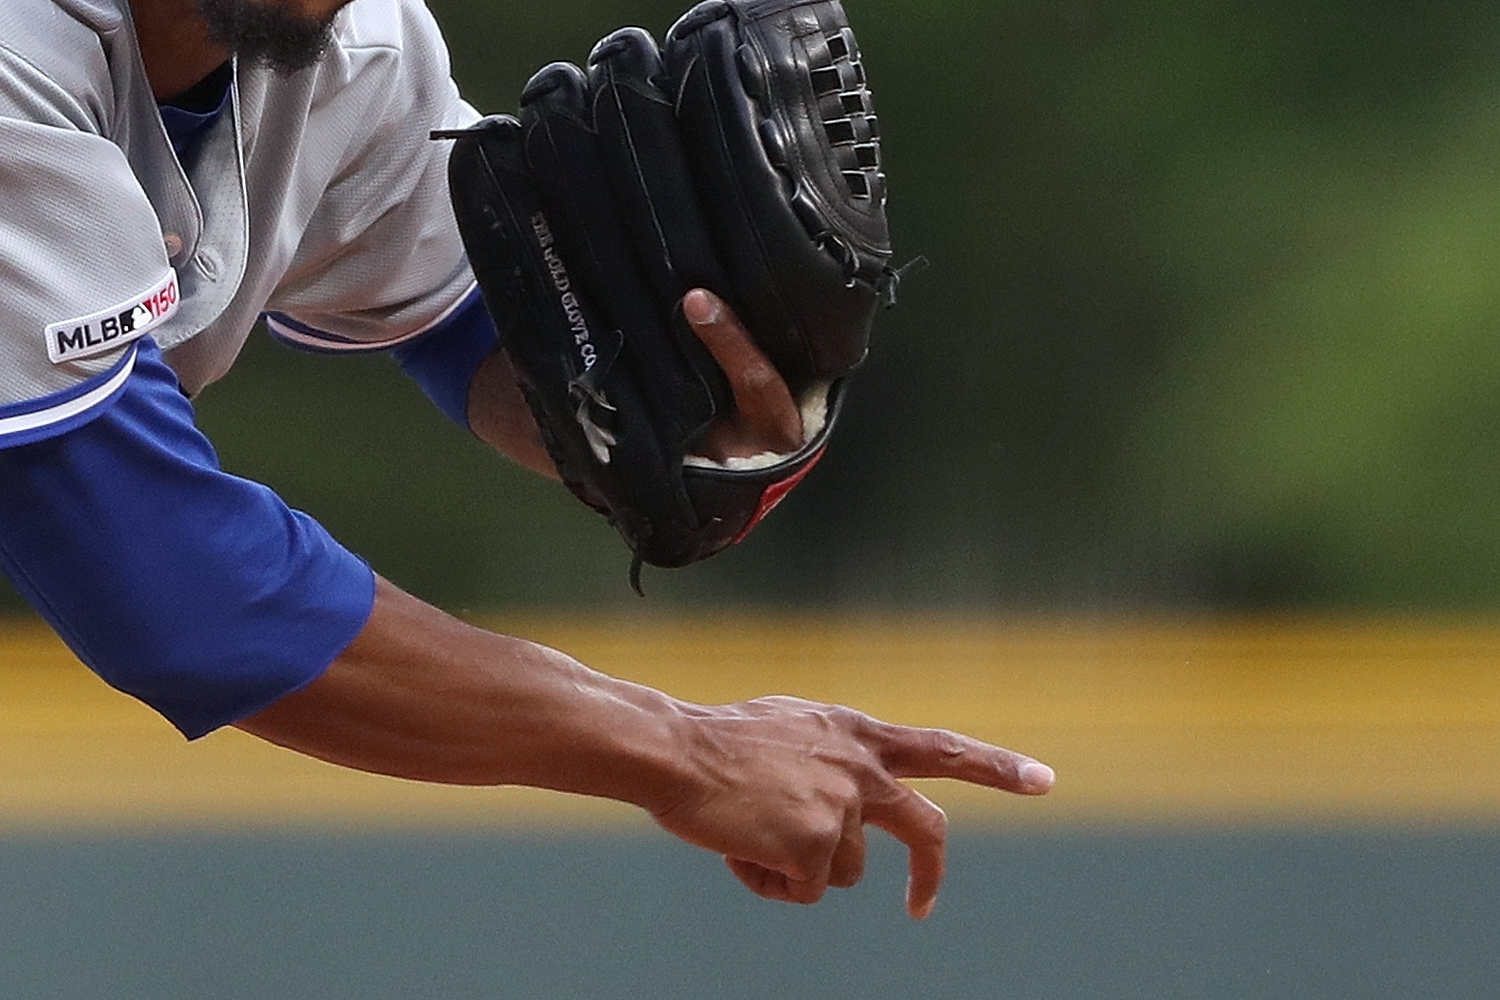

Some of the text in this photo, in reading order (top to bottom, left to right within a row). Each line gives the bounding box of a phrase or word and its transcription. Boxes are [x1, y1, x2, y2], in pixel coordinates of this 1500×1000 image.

[56, 281, 177, 354] MLB 150
[543, 247, 570, 292] GOLD
[560, 292, 591, 345] GLOVE
